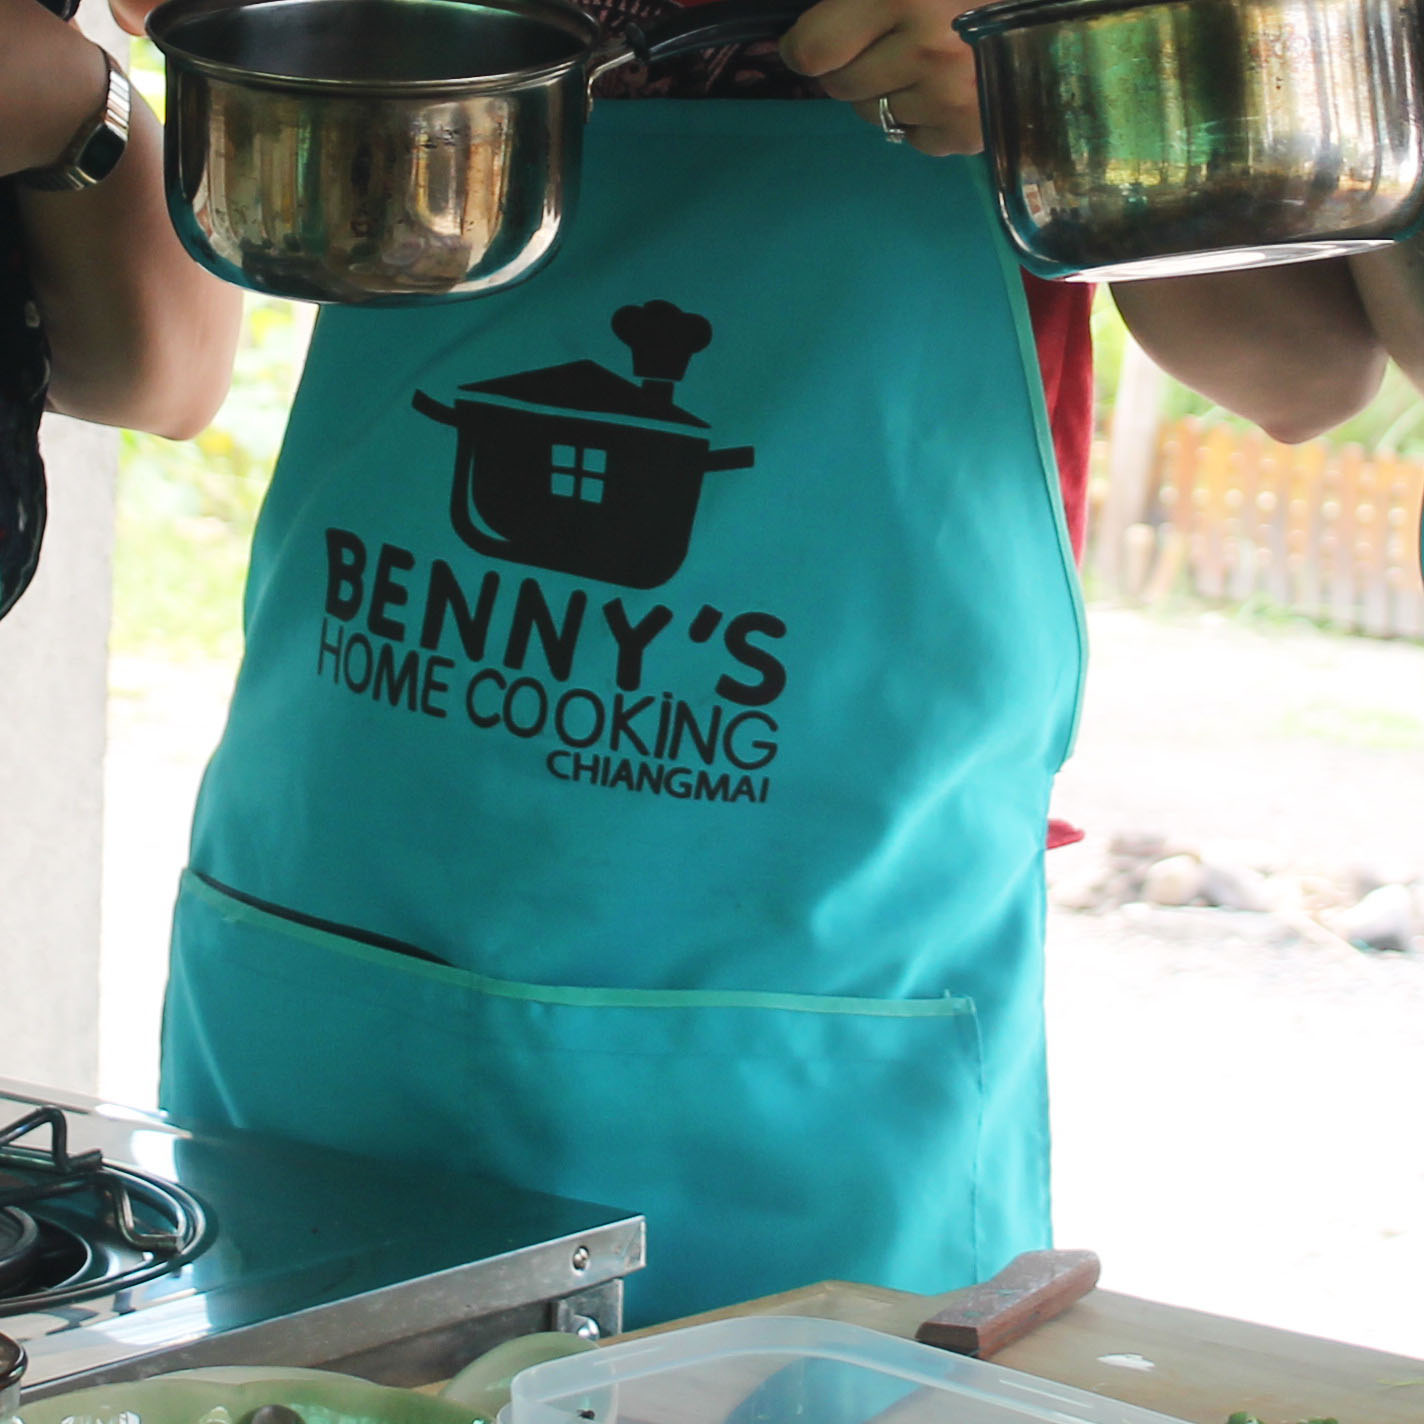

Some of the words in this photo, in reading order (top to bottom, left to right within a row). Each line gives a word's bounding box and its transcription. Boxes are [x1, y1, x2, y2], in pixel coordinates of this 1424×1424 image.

[325, 528, 786, 706] BENNY'S
[318, 618, 455, 719] HOME
[546, 749, 769, 803] CHIANGMAI
